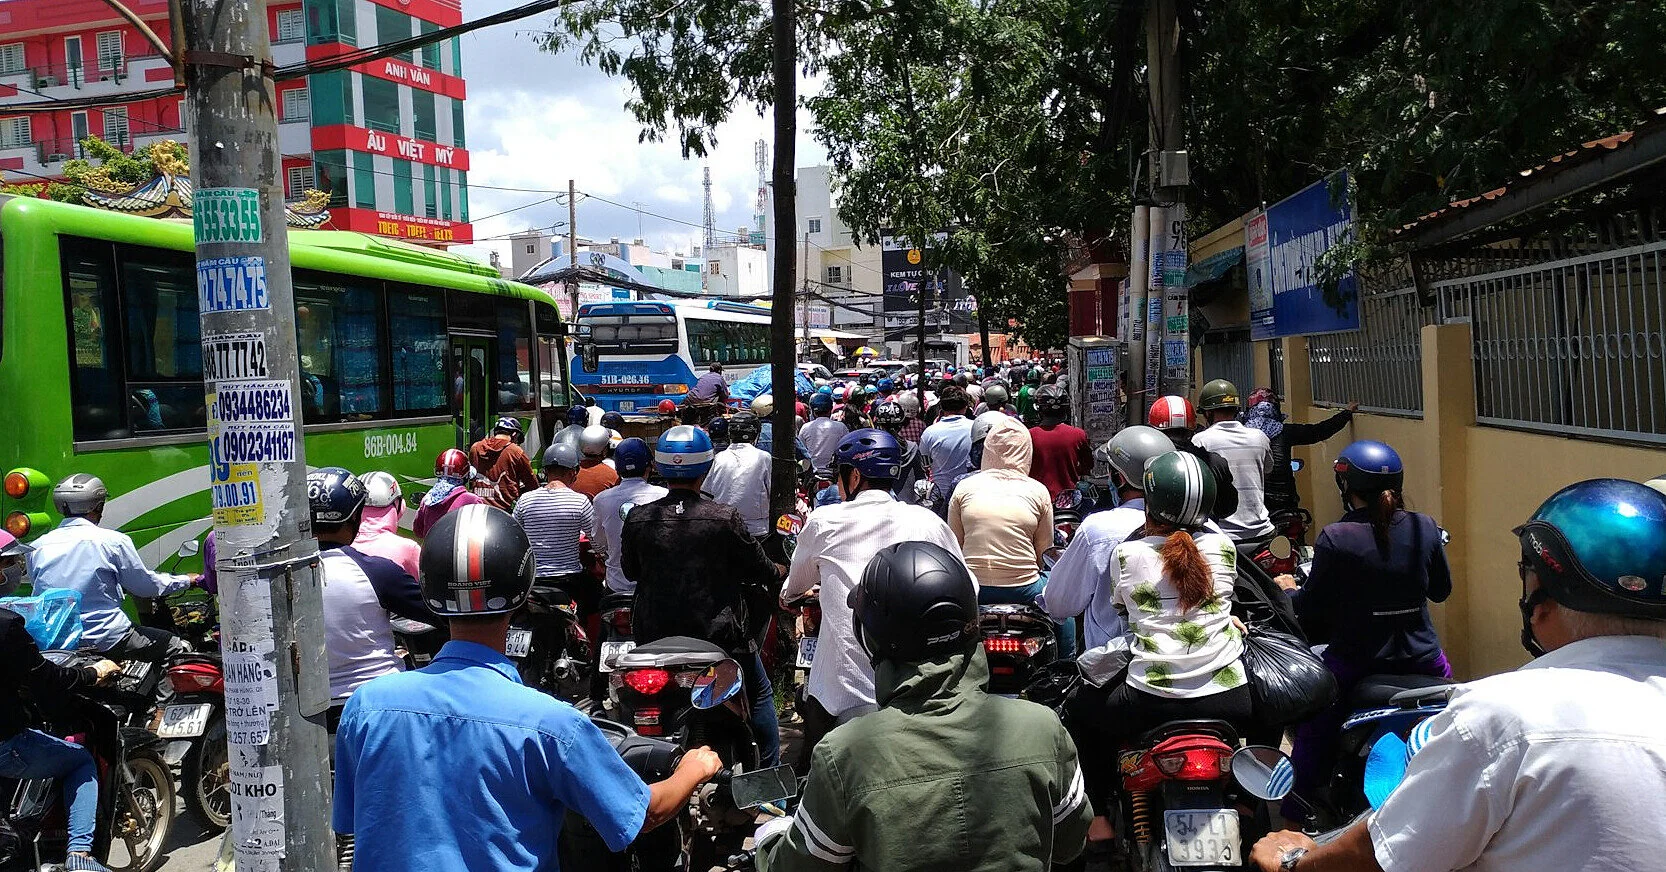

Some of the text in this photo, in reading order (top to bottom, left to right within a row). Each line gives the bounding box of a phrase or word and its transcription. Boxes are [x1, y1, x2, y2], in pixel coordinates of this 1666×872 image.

[385, 62, 430, 86] ANH VĂN
[366, 129, 454, 164] ÂU VIỆT MỸ
[377, 220, 400, 236] TOEIC
[907, 270, 918, 279] TỰ
[602, 374, 650, 384] 51B-026.46
[218, 390, 290, 421] 0934486234
[224, 431, 294, 462] 0902341187
[364, 432, 417, 458] 86B-004.84
[236, 658, 262, 682] HÀNG
[246, 704, 266, 717] LÊN
[244, 783, 277, 798] KHO
